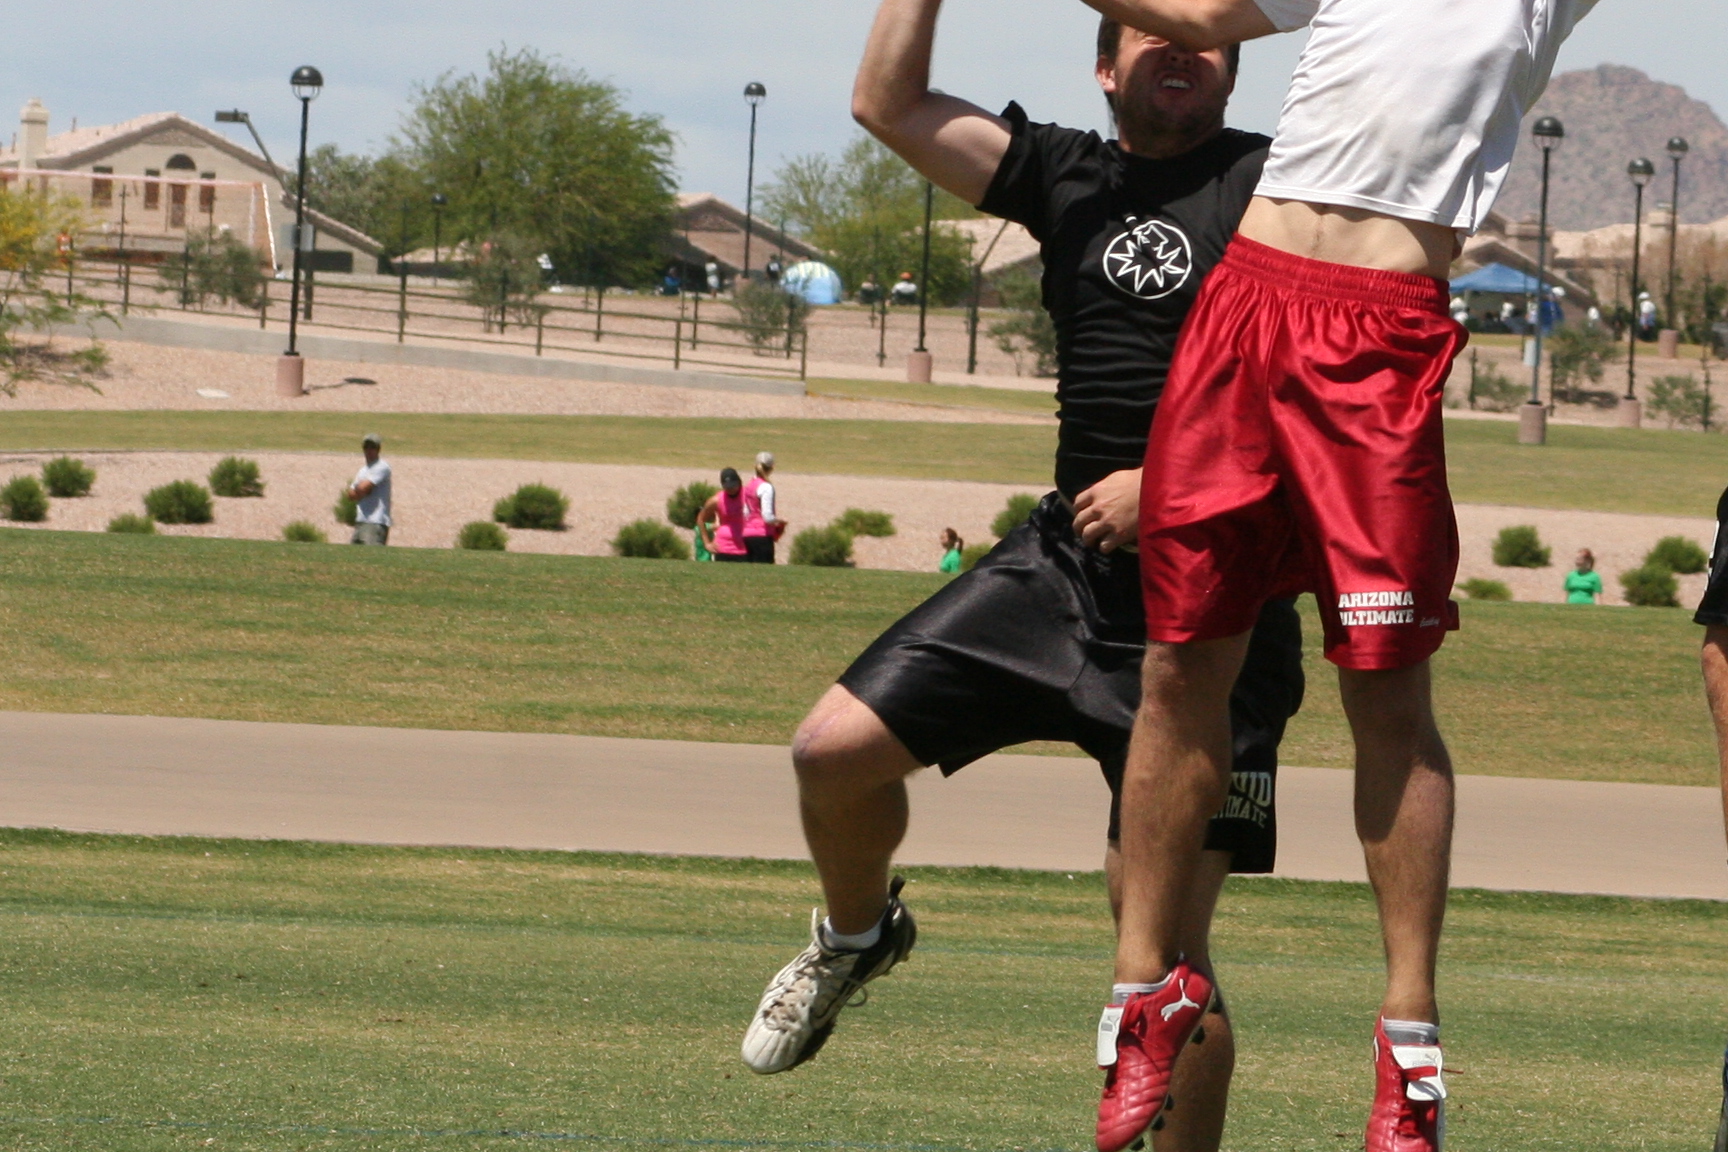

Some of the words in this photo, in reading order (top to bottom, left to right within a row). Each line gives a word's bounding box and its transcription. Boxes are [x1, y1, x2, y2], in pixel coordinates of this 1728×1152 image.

[1338, 591, 1414, 608] ARIZONA
[1339, 609, 1414, 626] ULTIMATE
[1230, 771, 1271, 807] UID
